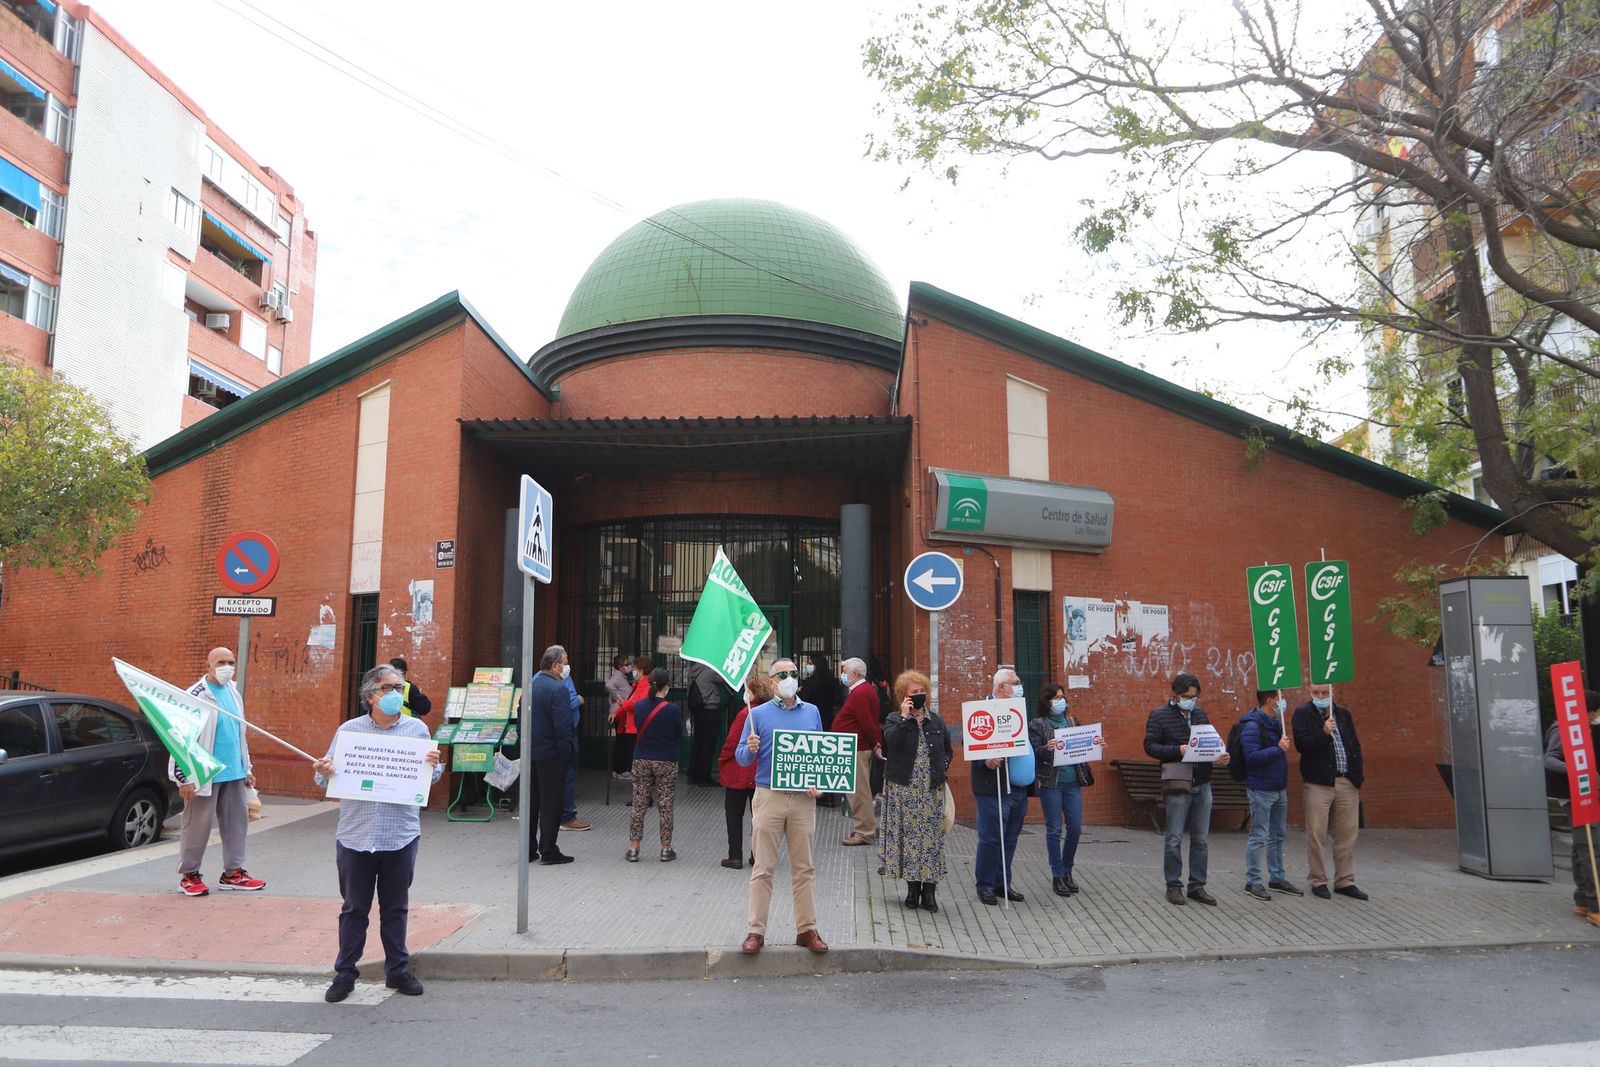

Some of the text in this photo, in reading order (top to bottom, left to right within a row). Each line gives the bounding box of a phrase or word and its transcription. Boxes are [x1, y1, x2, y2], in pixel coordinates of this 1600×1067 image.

[1042, 507, 1108, 526] Centro de Salud
[218, 606, 269, 614] MINUSVALIDO
[777, 733, 854, 756] SATSE
[358, 754, 391, 762] NUESTROS
[391, 757, 423, 765] DERECHOS
[776, 753, 852, 765] SINDICATO DE
[352, 769, 384, 777] PERSONAL
[385, 772, 418, 780] SANITARIO
[386, 765, 418, 773] MALTRATO
[776, 762, 852, 775] ENFERMERIA
[776, 772, 851, 790] HUELVA
